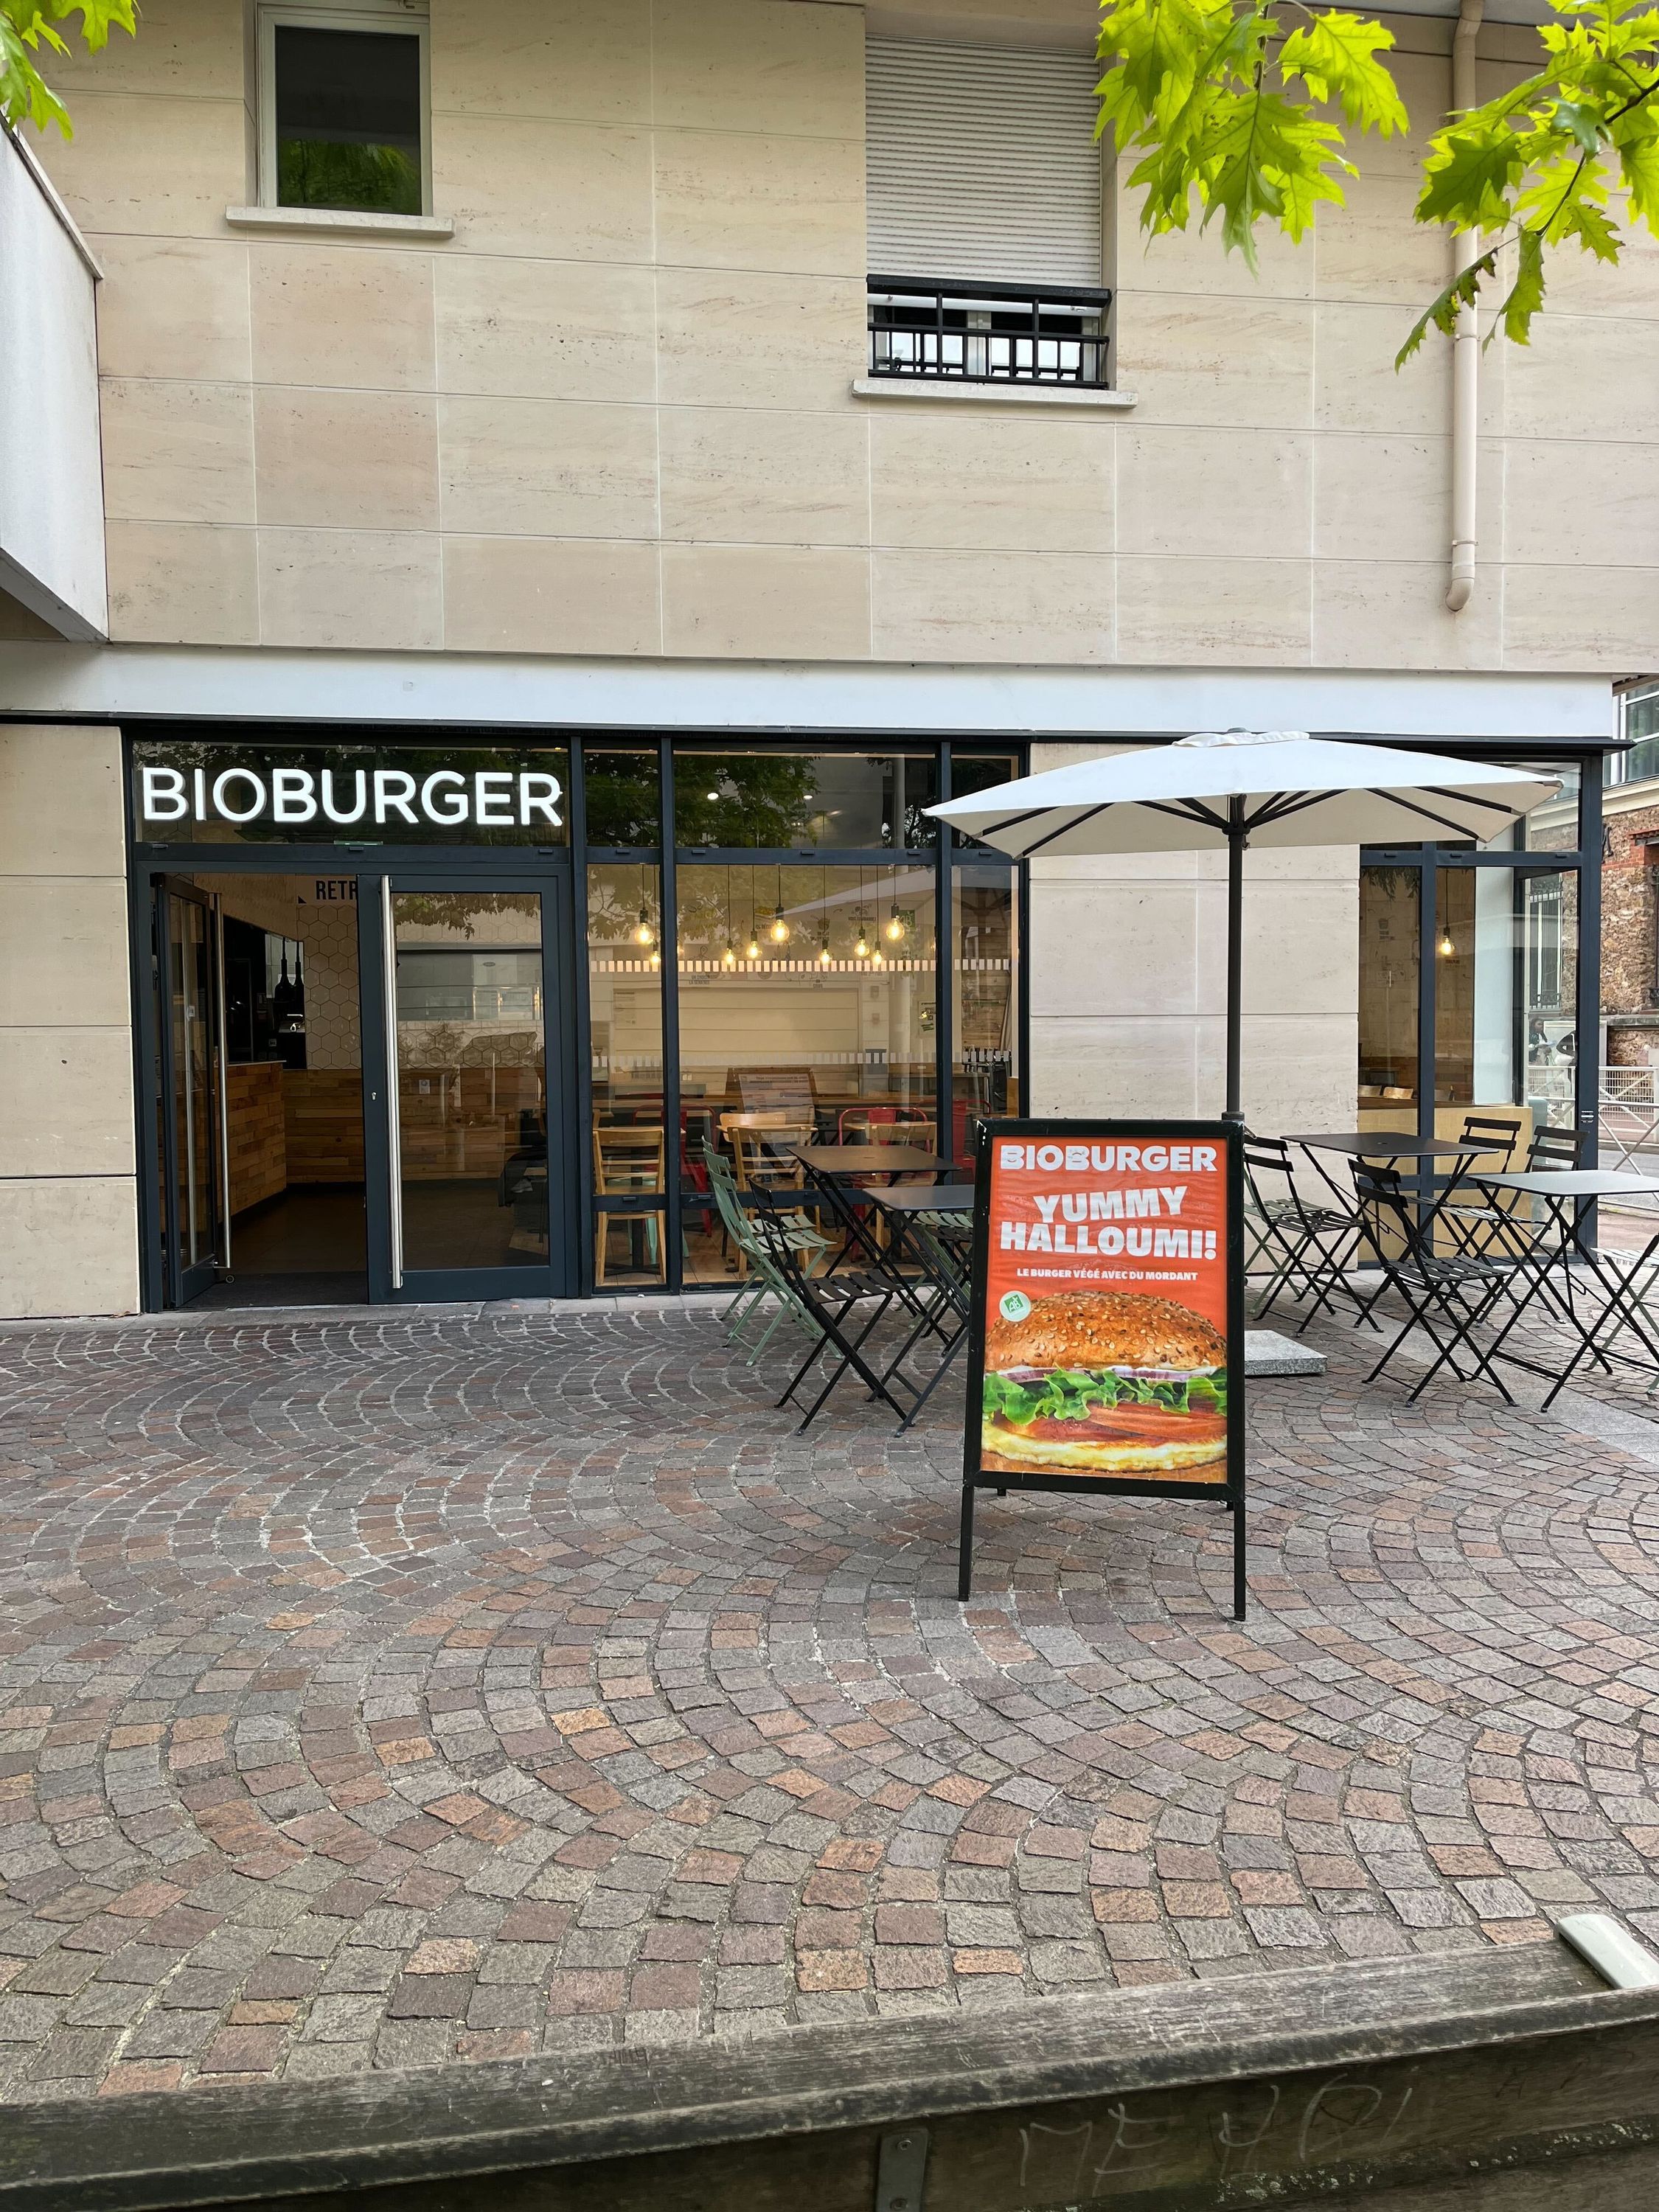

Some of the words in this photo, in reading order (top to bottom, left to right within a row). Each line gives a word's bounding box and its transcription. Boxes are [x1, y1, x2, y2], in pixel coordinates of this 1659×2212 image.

[142, 767, 563, 827] BIOBURGER
[1000, 1144, 1218, 1172] BIOBURGER
[1033, 1186, 1188, 1223] YUMMY
[1000, 1221, 1217, 1261] HALLOUMI!
[1017, 1267, 1029, 1277] LE
[1030, 1268, 1072, 1279] BURGER
[1073, 1268, 1100, 1279] VÉGÉ
[1101, 1270, 1128, 1280] AVEC
[1129, 1271, 1144, 1281] DU
[1145, 1272, 1198, 1281] MORDANT
[1009, 1298, 1021, 1312] AB
